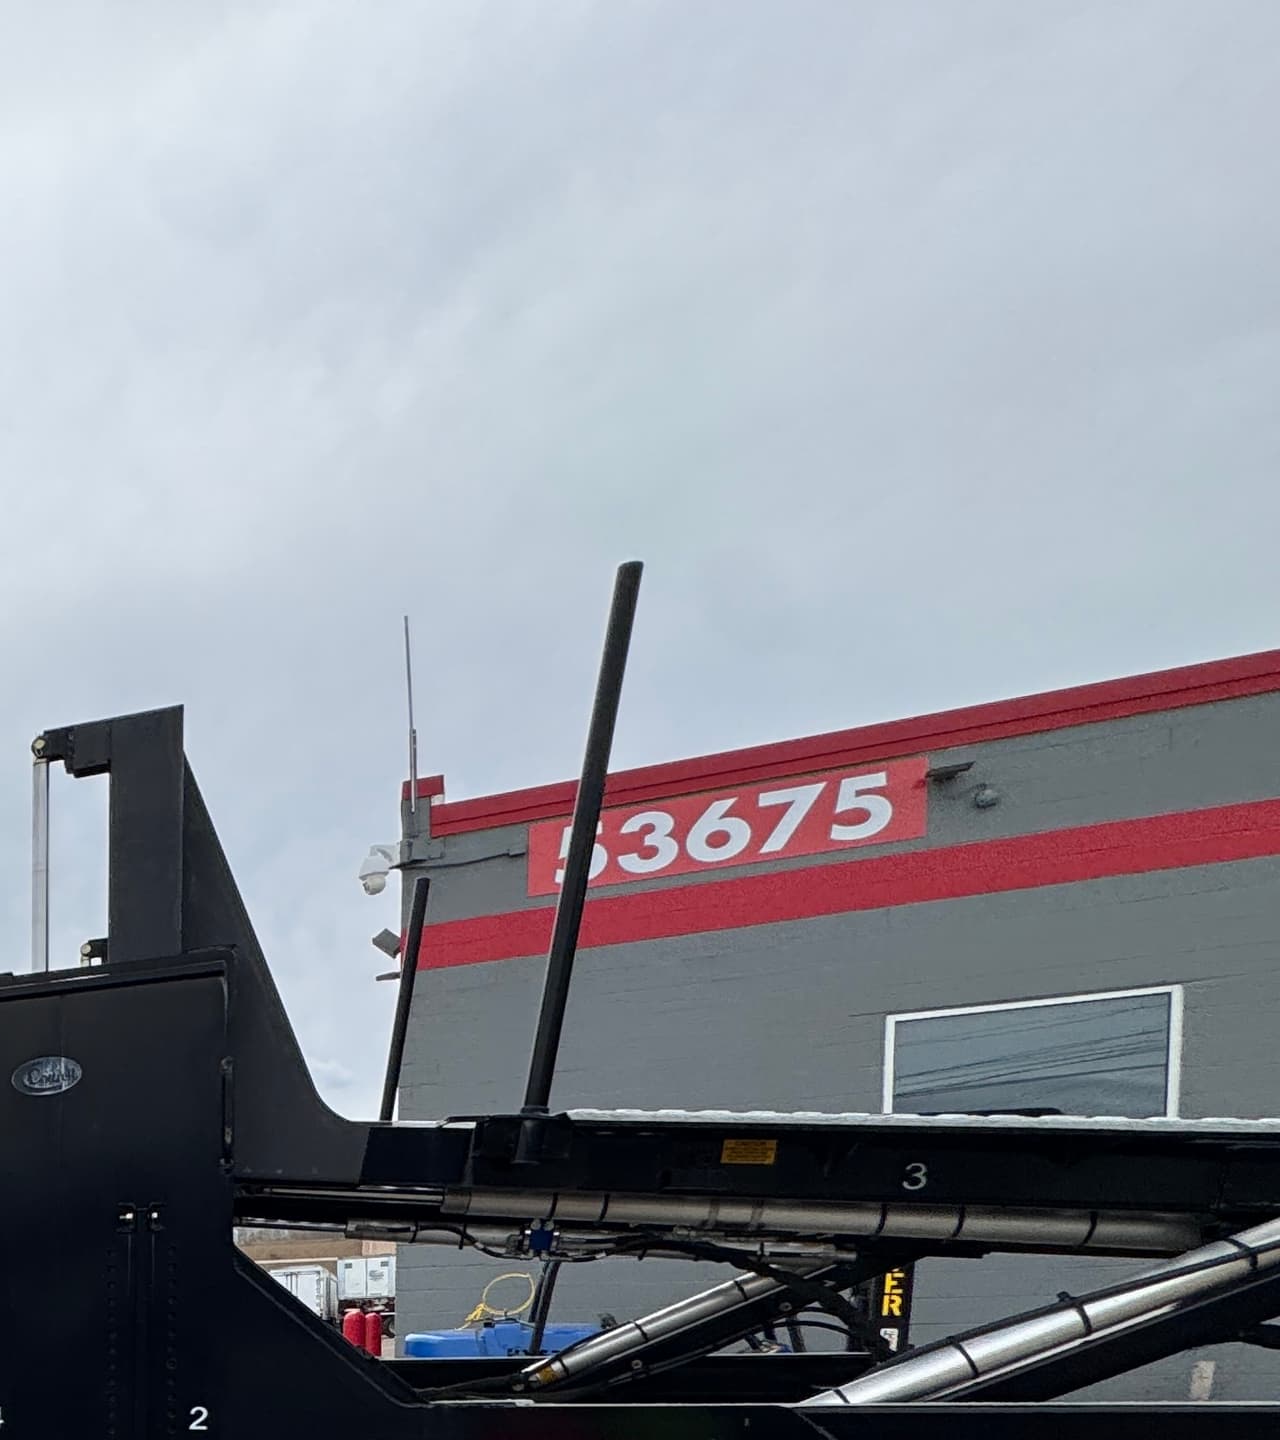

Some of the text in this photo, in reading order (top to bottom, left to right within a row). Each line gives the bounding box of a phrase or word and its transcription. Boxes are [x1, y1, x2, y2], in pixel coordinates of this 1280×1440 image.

[902, 1163, 928, 1190] 3
[881, 1268, 906, 1317] ER
[188, 1406, 209, 1431] 2
